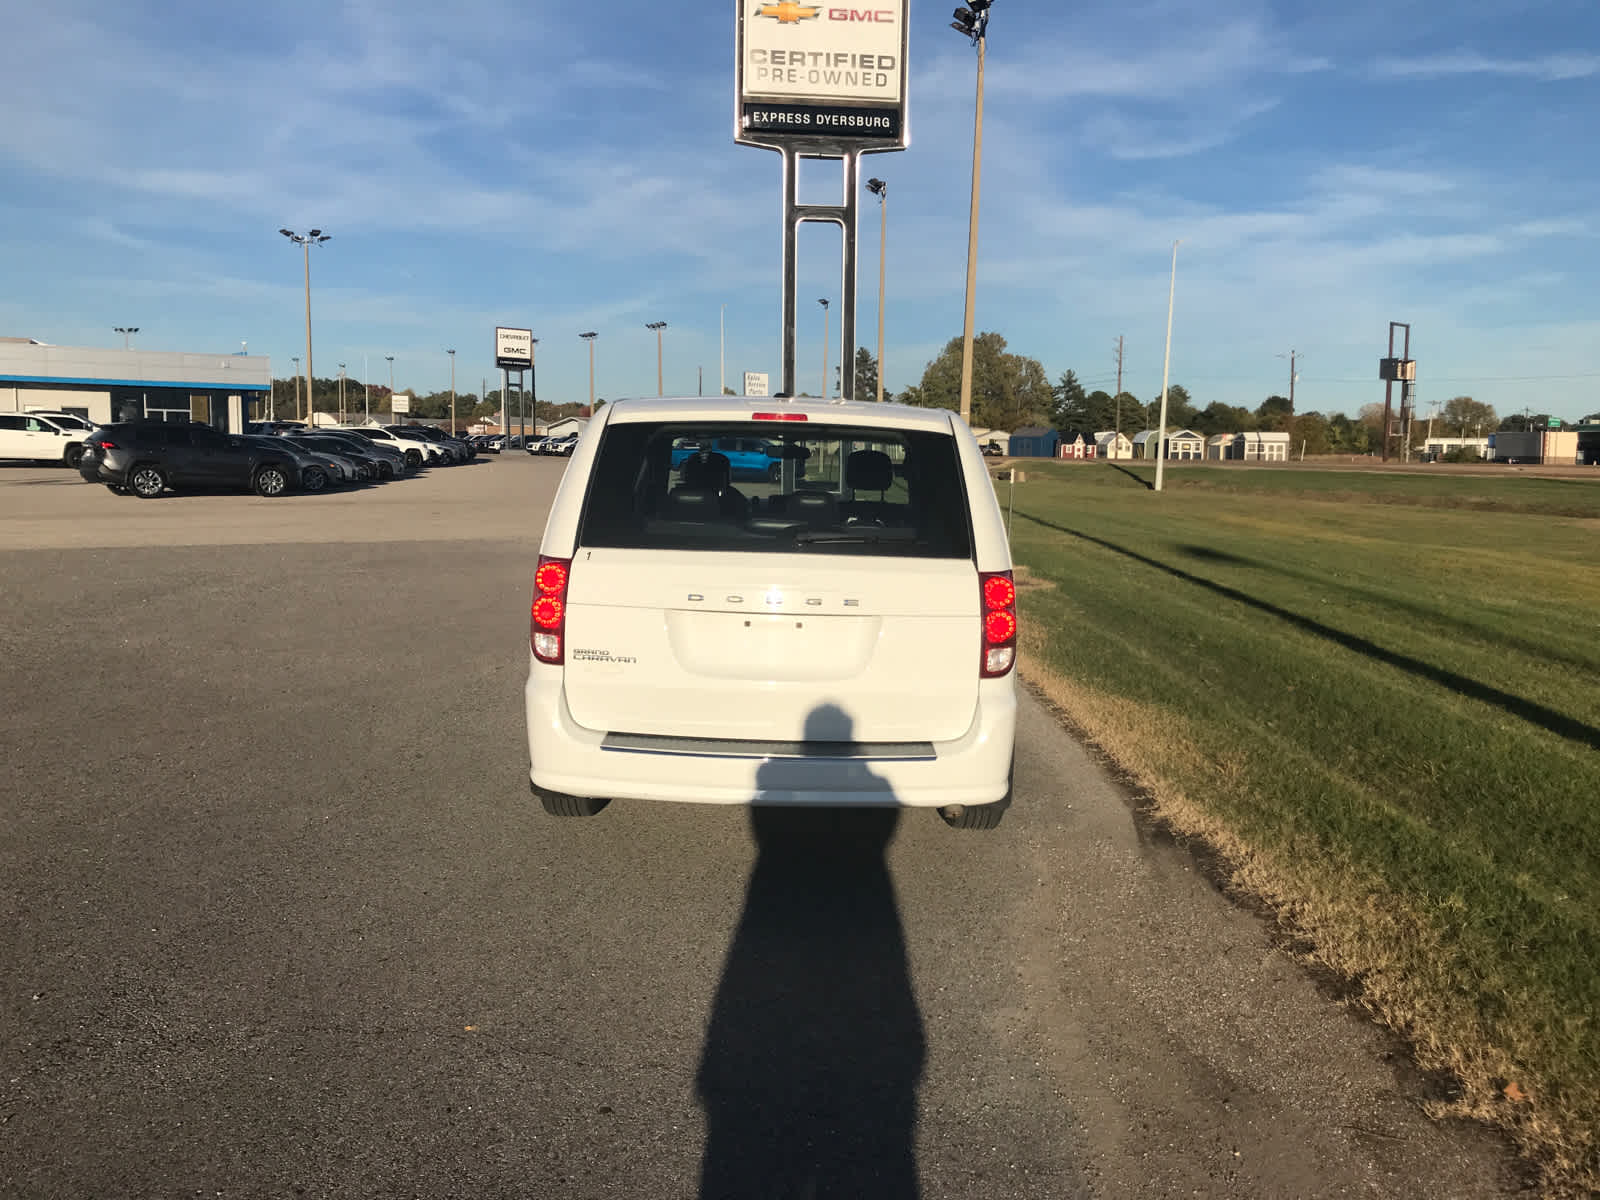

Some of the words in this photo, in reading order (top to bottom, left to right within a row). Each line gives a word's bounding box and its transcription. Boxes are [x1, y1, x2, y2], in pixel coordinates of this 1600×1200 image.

[828, 8, 894, 23] GMC
[750, 49, 896, 70] CERTIFIED
[757, 67, 888, 87] PRE-OWNED
[753, 111, 811, 124] EXPRESS
[816, 114, 890, 128] DYERSBURG
[687, 593, 859, 607] DODGE
[572, 654, 637, 664] CARAVAN
[573, 648, 610, 656] GRAND
